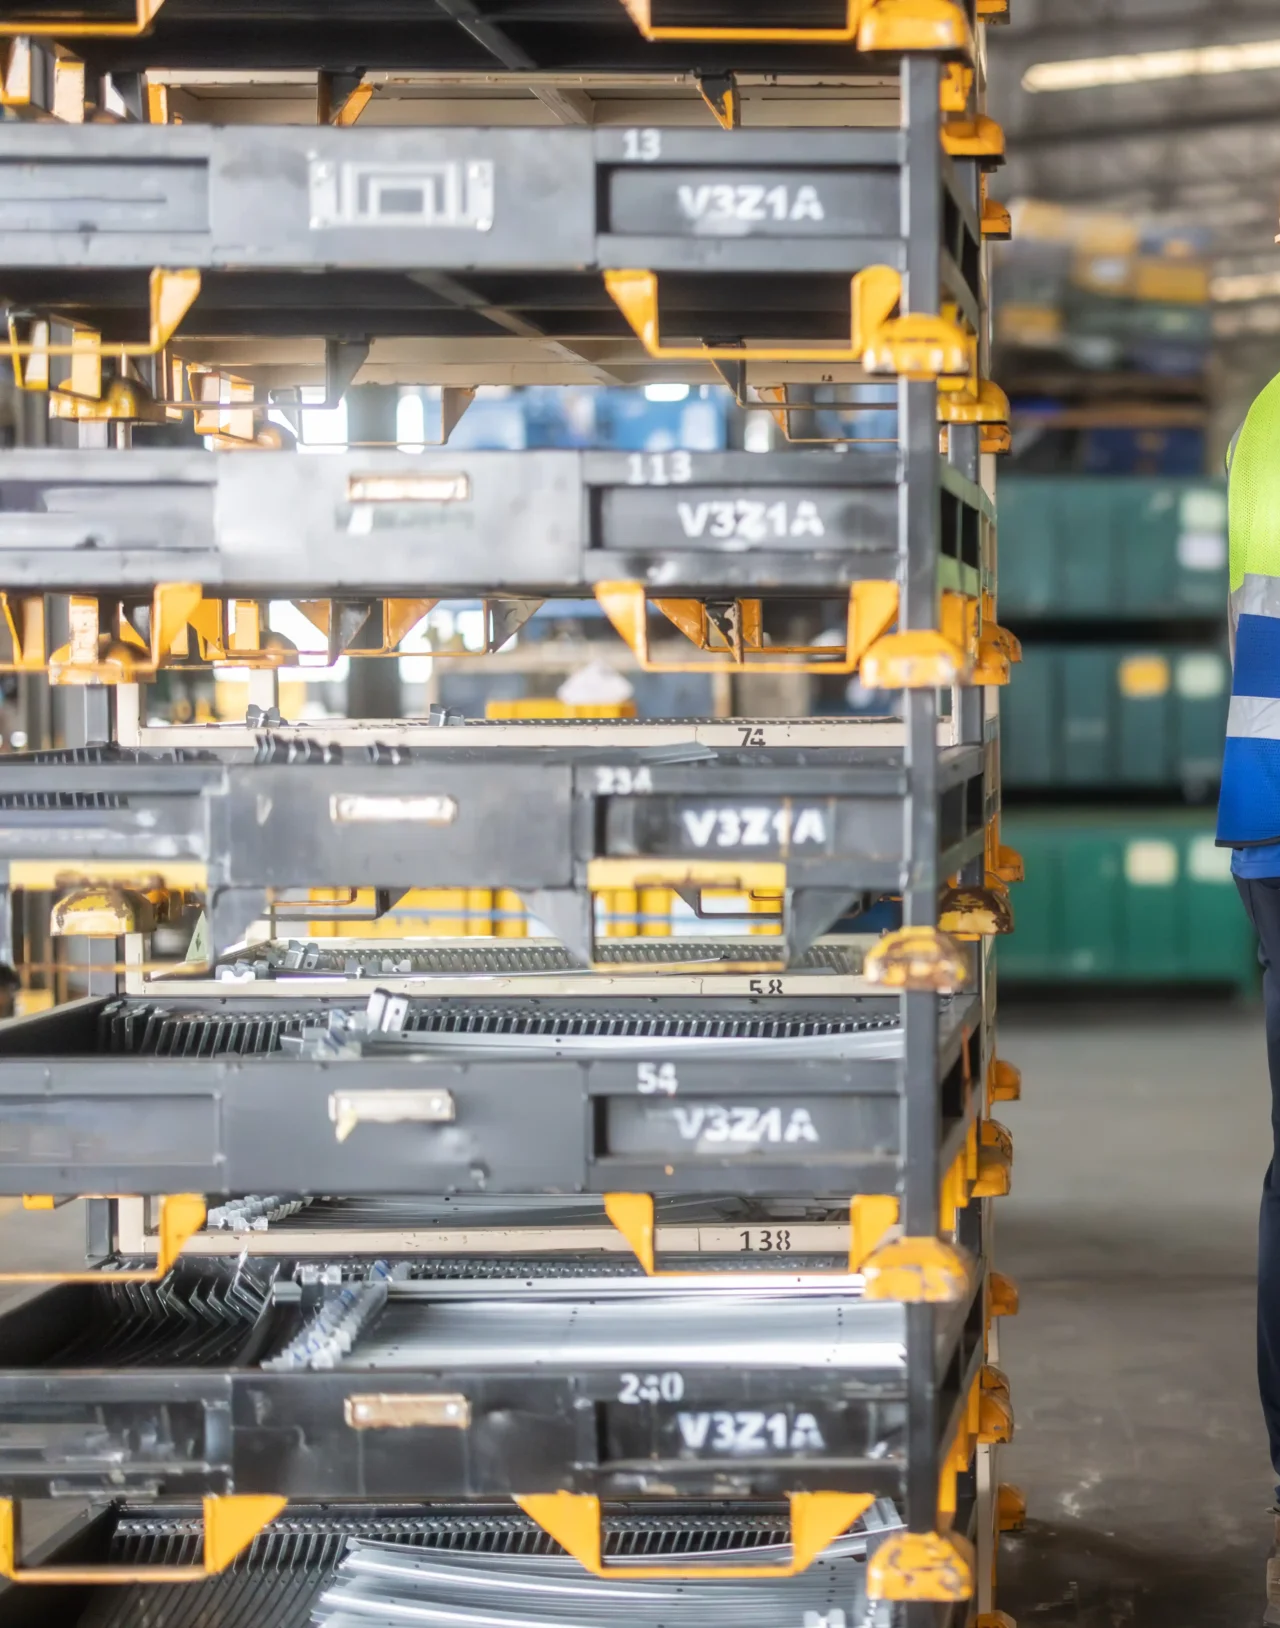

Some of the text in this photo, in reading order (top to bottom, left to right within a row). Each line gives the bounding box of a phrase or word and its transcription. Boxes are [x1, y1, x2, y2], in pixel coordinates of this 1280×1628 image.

[622, 127, 662, 161] 13
[677, 184, 826, 221] V3Z1A
[627, 451, 692, 485] 113
[677, 500, 826, 538] V3Z1A
[737, 727, 767, 747] 74
[682, 808, 827, 848] V3Z1A
[637, 1061, 679, 1096] 54
[672, 1105, 820, 1143] V3Z1A
[739, 1229, 792, 1252] 138
[617, 1371, 685, 1405] 240
[677, 1410, 826, 1451] V3Z1A
